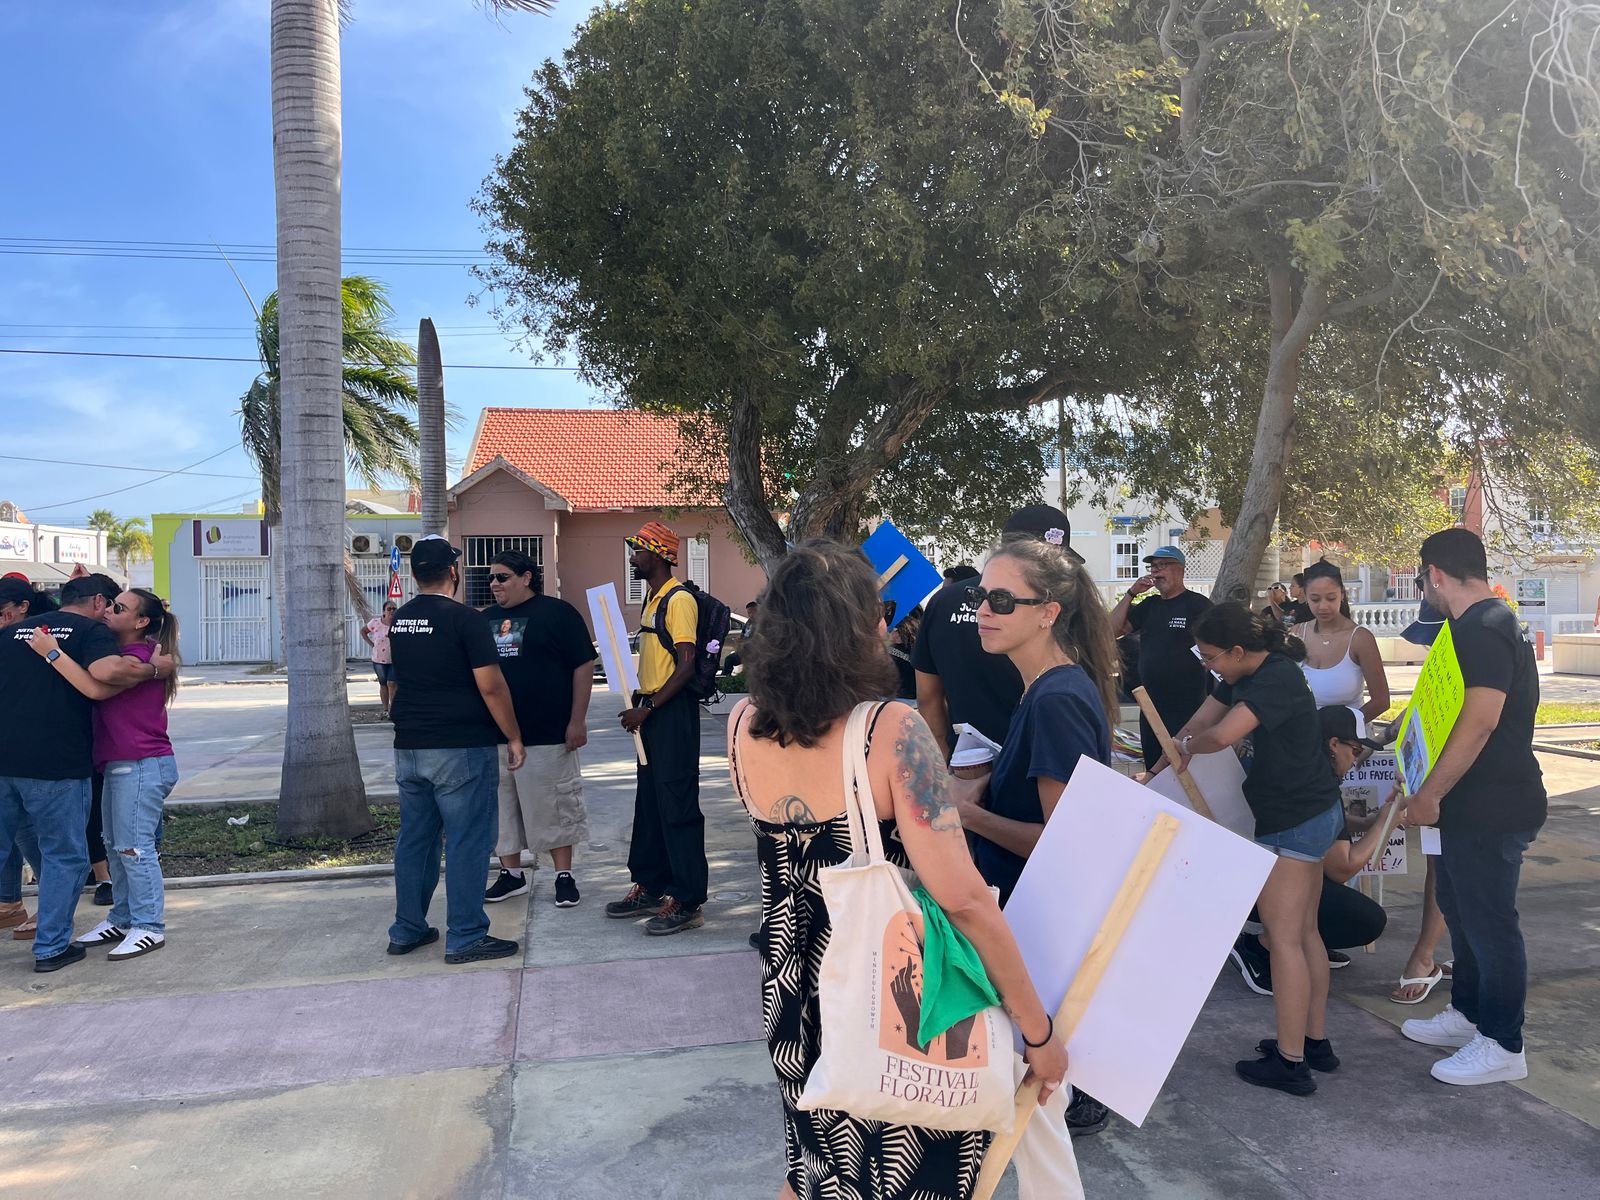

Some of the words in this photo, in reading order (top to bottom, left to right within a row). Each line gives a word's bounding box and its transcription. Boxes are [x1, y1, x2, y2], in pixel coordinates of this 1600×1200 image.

[950, 613, 978, 624] Ayde
[416, 626, 434, 634] Lanoy
[1358, 771, 1367, 780] DI
[1370, 770, 1397, 781] FAYEC
[885, 1054, 980, 1090] FESTIVAL
[879, 1074, 979, 1108] FLORALIA
